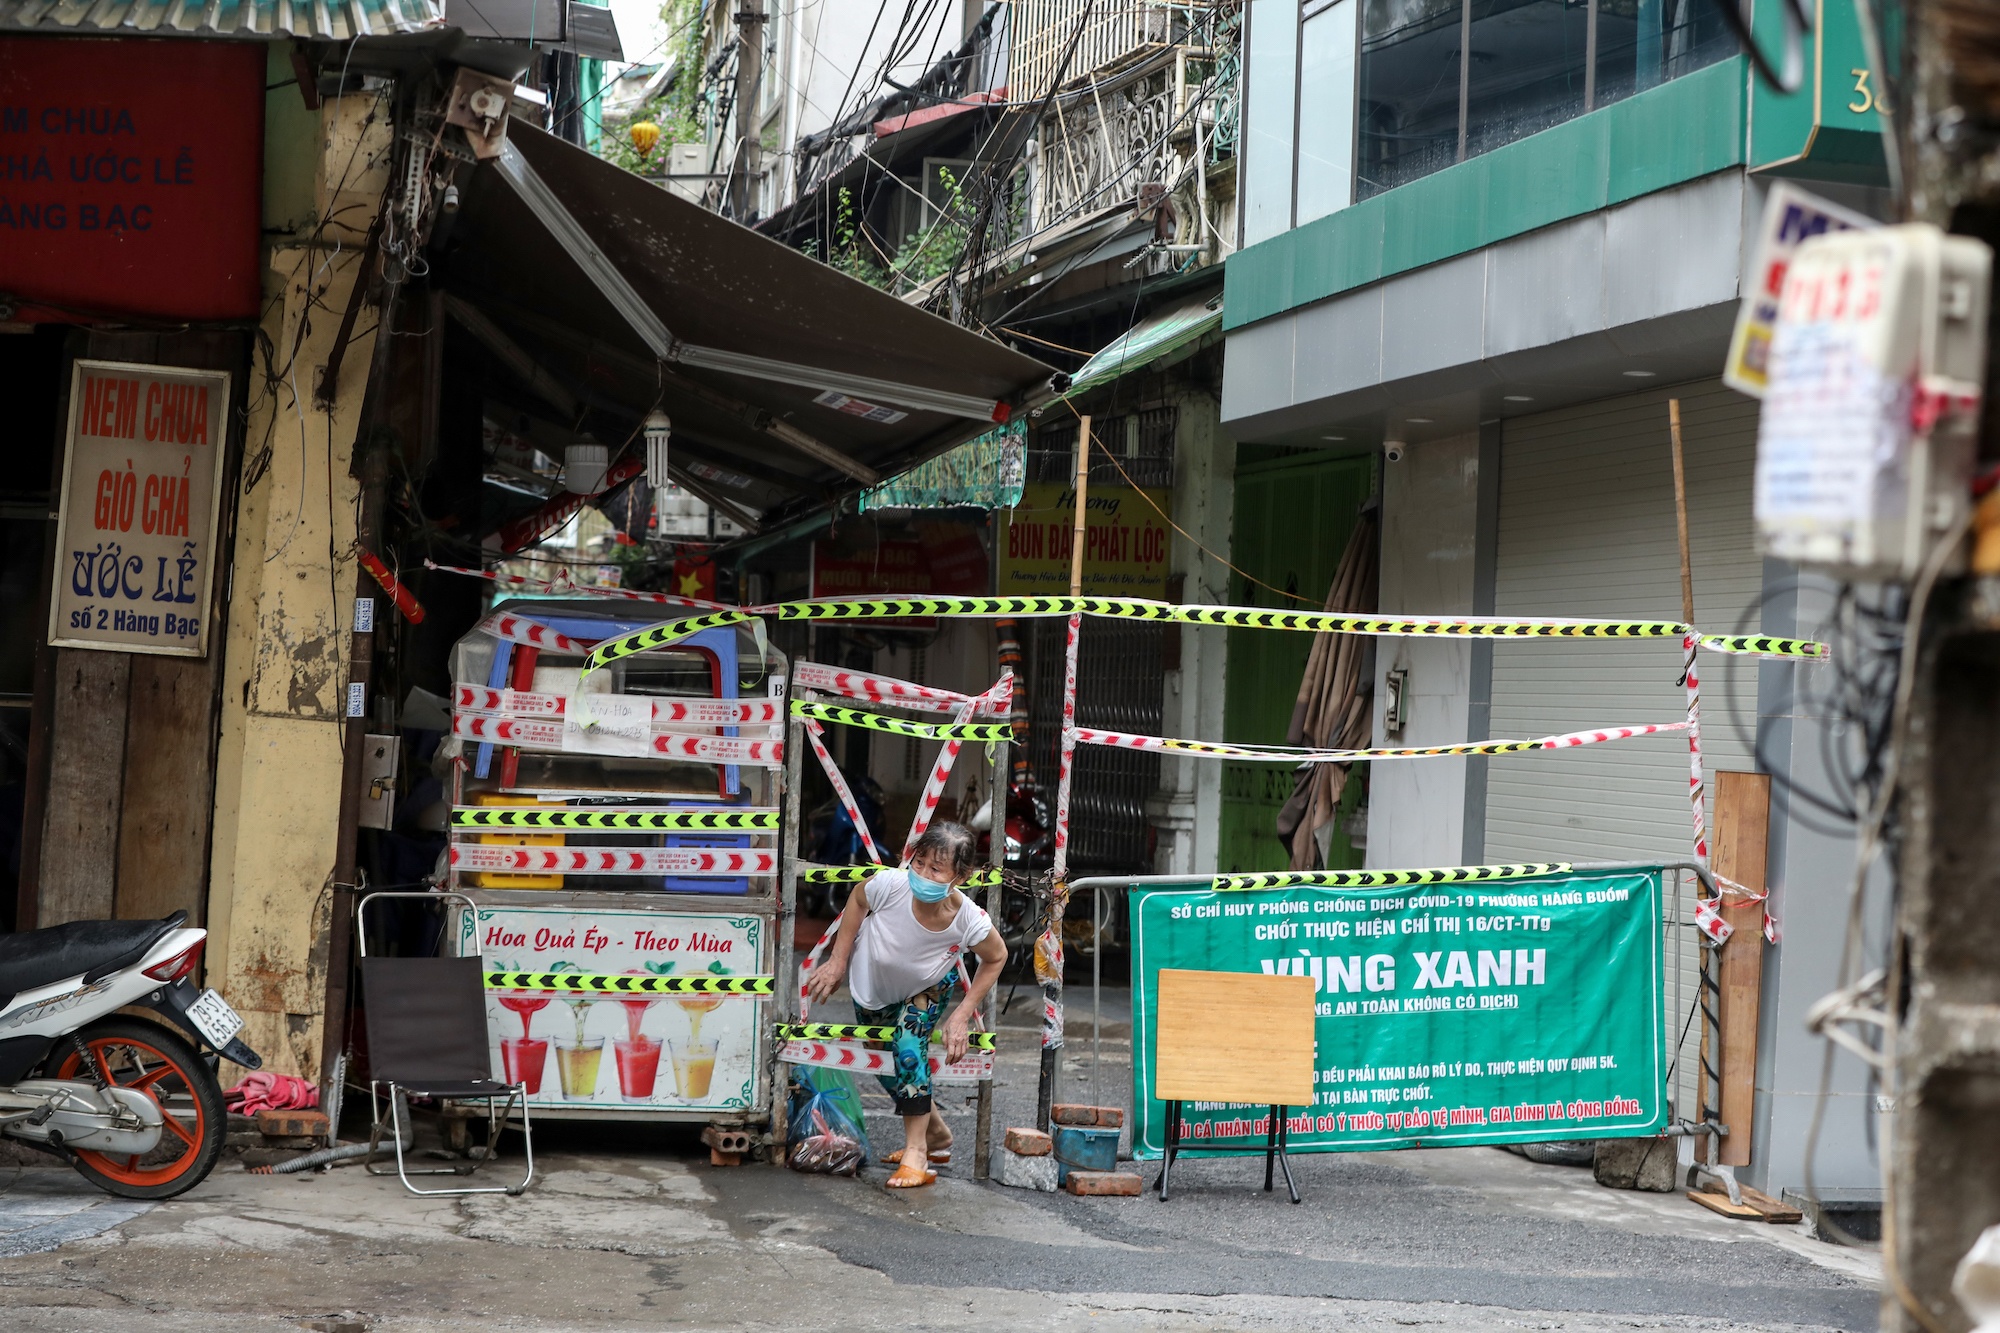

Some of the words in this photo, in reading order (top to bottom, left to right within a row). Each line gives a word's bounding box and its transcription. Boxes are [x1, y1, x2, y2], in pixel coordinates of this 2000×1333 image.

[41, 107, 136, 136] CHUA
[0, 147, 54, 182] HẢ
[69, 148, 142, 183] ƯỚC
[154, 147, 195, 185] LỄ
[79, 204, 153, 237] BẠC
[81, 375, 140, 440] NEM
[144, 381, 209, 446] CHUA
[94, 458, 137, 534] GIÒ
[141, 455, 190, 538] CHẢ
[1008, 515, 1044, 560] BÚN
[1048, 516, 1075, 569] ĐẬ
[1087, 513, 1130, 563] PHẤT
[1134, 519, 1165, 572] LỘC
[72, 542, 144, 600] ƯỚC
[152, 541, 198, 605] LỄ
[70, 604, 96, 630] số
[97, 609, 109, 631] 2
[113, 608, 159, 637] Hàng
[164, 614, 200, 641] Bạc
[773, 684, 784, 697] B
[1171, 902, 1191, 919] SỞ
[1196, 900, 1221, 918] CHỈ
[1225, 903, 1254, 917] HUY
[1259, 899, 1309, 915] PHÒNG
[1313, 896, 1366, 912] CHỐNG
[1371, 897, 1404, 914] DỊCH
[1408, 894, 1475, 909] COVID-19
[1479, 892, 1538, 908] PHƯỜNG
[1542, 890, 1583, 906] HÀNG
[485, 926, 527, 947] Hoa
[533, 927, 576, 952] Quả
[583, 925, 609, 954] Ép
[634, 930, 680, 951] Theo
[686, 932, 733, 953] Mùa
[1255, 918, 1298, 940] CHỐT
[1304, 920, 1350, 941] THỰC
[1355, 917, 1396, 939] HIỆN
[1401, 912, 1430, 934] CHỈ
[1434, 916, 1460, 935] THỊ
[1466, 914, 1551, 932] 16/CT-TTg
[1412, 948, 1547, 990] XANH
[1336, 1000, 1358, 1015] AN
[1361, 996, 1399, 1014] TOÀN
[1404, 994, 1450, 1012] KHÔNG
[1456, 993, 1475, 1009] CÓ
[1480, 993, 1519, 1011] DỊCH)
[1322, 1065, 1345, 1084] ĐỀU
[1348, 1065, 1376, 1082] PHẢI
[1379, 1066, 1406, 1081] KHAI
[1408, 1062, 1430, 1080] BÁO
[1432, 1061, 1447, 1077] RÕ
[1449, 1060, 1462, 1077] LÝ
[1465, 1062, 1484, 1077] DO,
[1487, 1060, 1516, 1078] THỰC
[1518, 1057, 1544, 1076] HIỆN
[1547, 1058, 1569, 1074] QUY
[1571, 1055, 1597, 1073] ĐỊNH
[1600, 1055, 1618, 1069] 5K.
[1322, 1091, 1340, 1107] TẠI
[1344, 1088, 1368, 1104] BÀN
[1370, 1087, 1400, 1104] TRỰC
[1403, 1082, 1434, 1101] CHỐT.
[1194, 1118, 1213, 1139] CÁ
[1215, 1115, 1252, 1138] NHÂN
[1285, 1111, 1314, 1135] PHẢI
[1317, 1111, 1335, 1133] CÓ
[1337, 1110, 1348, 1132] Ý
[1349, 1110, 1383, 1132] THỨC
[1386, 1110, 1404, 1133] TỰ
[1404, 1106, 1430, 1129] BẢO
[1432, 1107, 1449, 1130] VỆ
[1450, 1104, 1488, 1127] MÌNH,
[1489, 1105, 1512, 1123] GIA
[1514, 1101, 1545, 1122] ĐÌNH
[1547, 1100, 1565, 1122] VÀ
[1566, 1098, 1601, 1122] CỘNG
